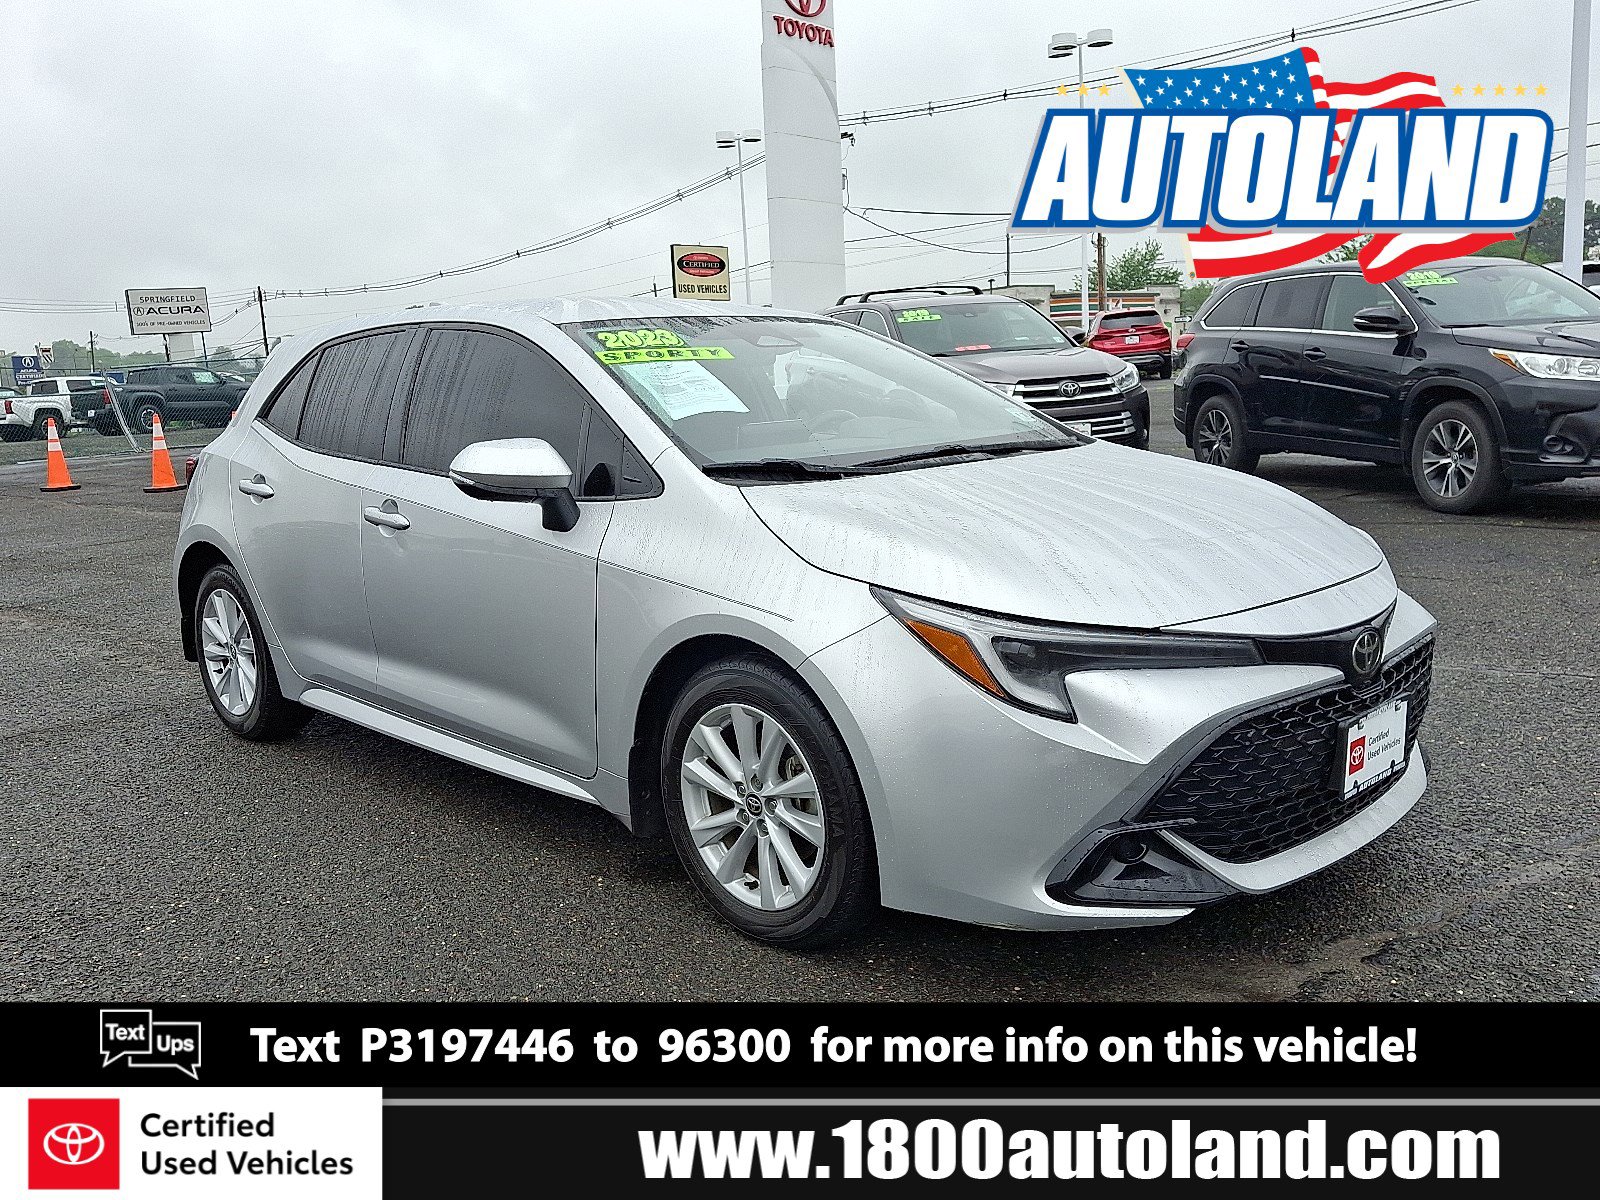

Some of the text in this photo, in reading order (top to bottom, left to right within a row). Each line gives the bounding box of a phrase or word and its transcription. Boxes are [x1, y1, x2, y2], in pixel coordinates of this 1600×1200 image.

[772, 14, 834, 47] TOYOTA
[682, 260, 720, 268] CERTIFIED
[678, 283, 728, 293] USED VEHICLES
[139, 295, 196, 303] SPRINGFIELD
[145, 305, 205, 315] ACURA
[597, 328, 686, 348] 2023
[602, 348, 721, 361] SPORTY
[1368, 728, 1390, 746] Certified
[1367, 737, 1401, 760] Used Vehicles
[1359, 769, 1392, 792] AUTOLAND
